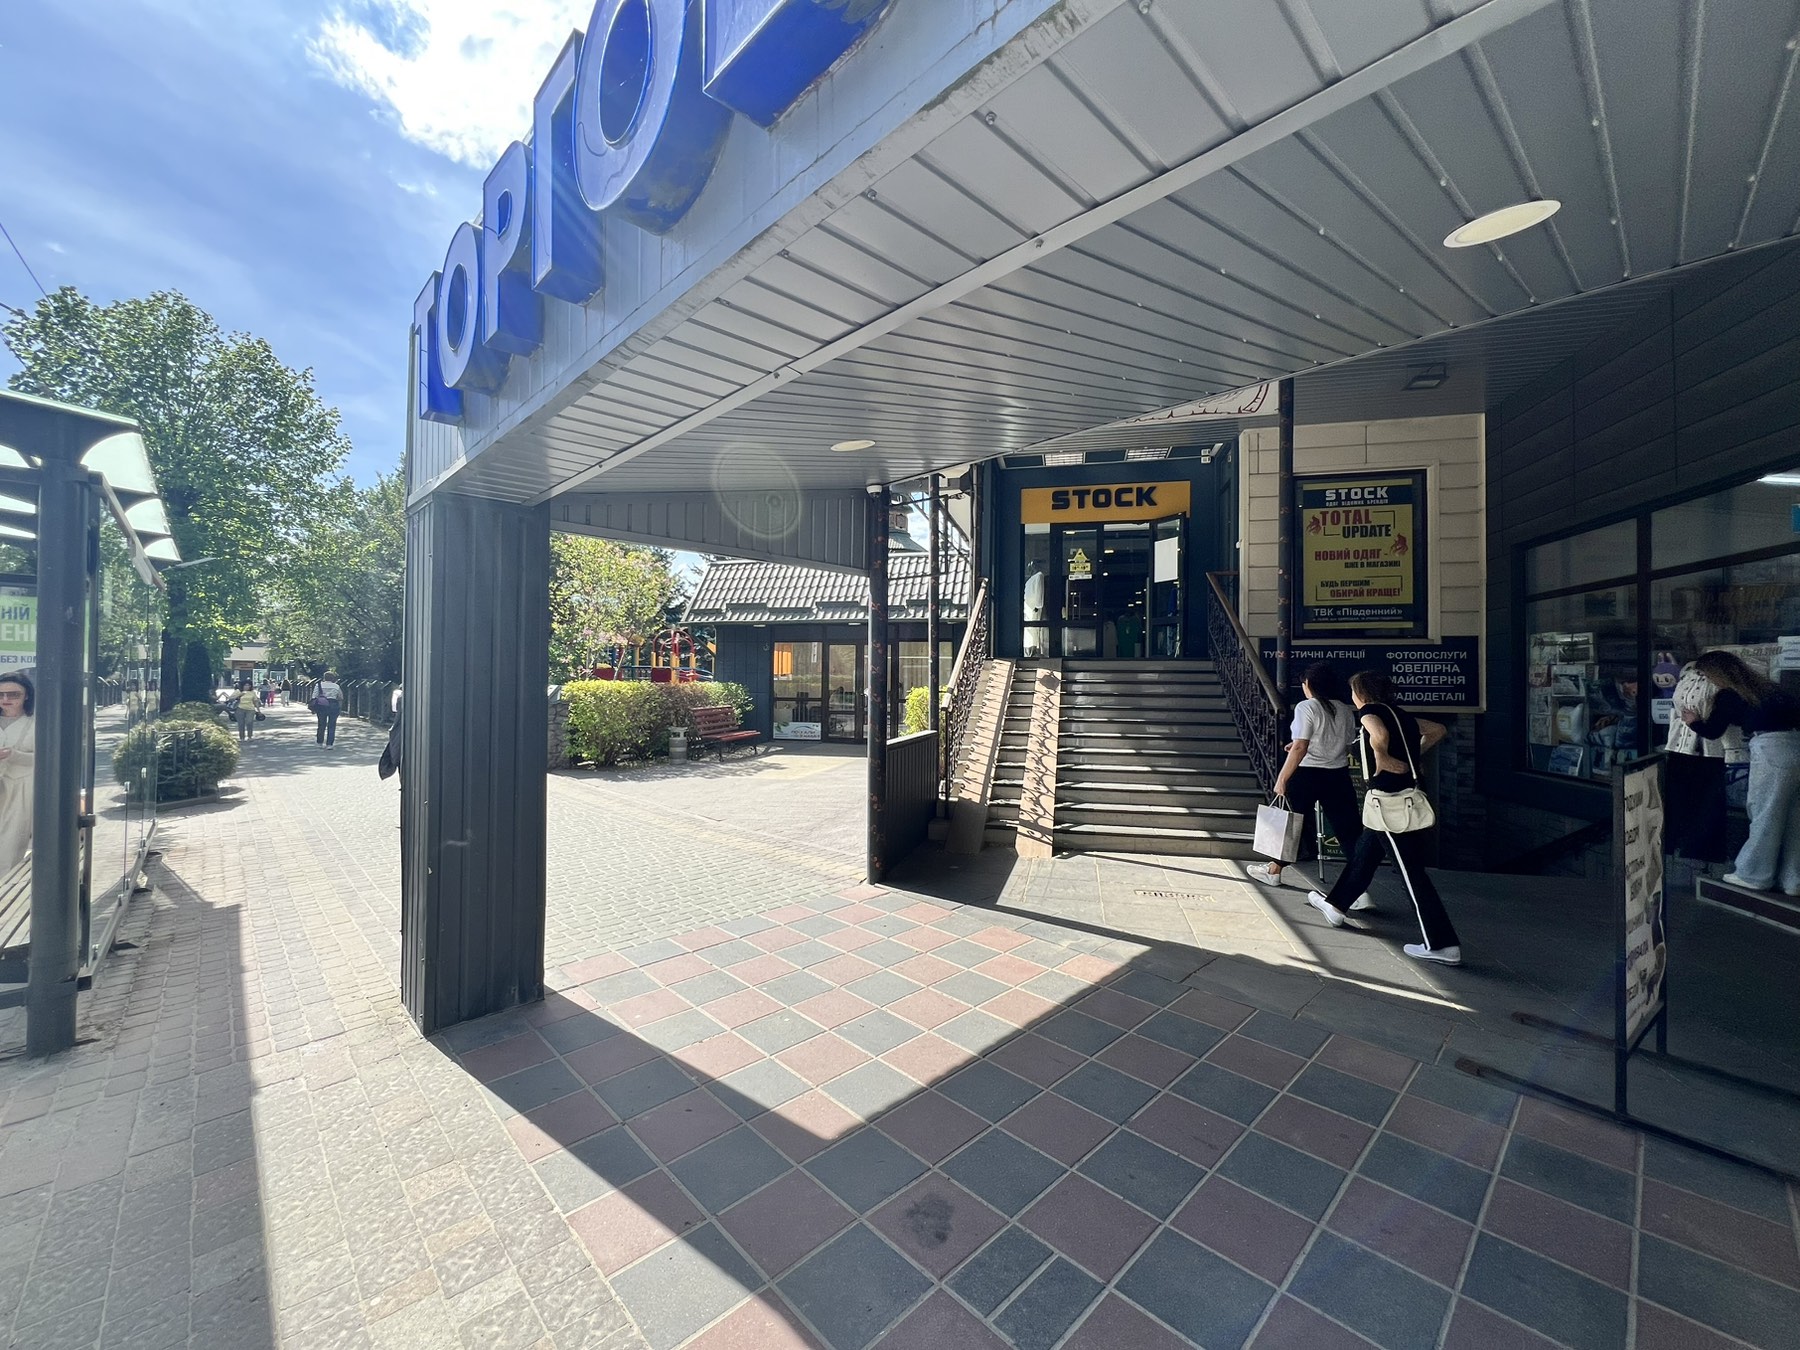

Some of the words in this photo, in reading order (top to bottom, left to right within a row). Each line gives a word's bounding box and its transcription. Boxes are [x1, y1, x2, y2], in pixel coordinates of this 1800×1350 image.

[1051, 486, 1158, 510] STOCK
[1325, 487, 1388, 501] STOCK
[1320, 509, 1372, 526] TOTAL
[1342, 525, 1392, 538] UPDATE
[1314, 548, 1350, 561] НОВИЙ
[1353, 549, 1382, 561] ОДЯГ
[1366, 560, 1401, 568] МАГАЗИНІ
[1320, 580, 1339, 588] БУДЬ
[1330, 587, 1364, 598] ОБИРАЙ
[1366, 587, 1401, 598] КРАЩЕ!
[1313, 608, 1334, 616] ТВК
[1336, 606, 1403, 617] «Південний»
[0, 655, 18, 663] БЕЗ
[1327, 650, 1366, 660] АГЕНЦІЇ
[1386, 651, 1467, 660] ФОТОПОСЛУГИ
[1392, 664, 1461, 673] ЮВЕЛІРНА
[1388, 673, 1466, 684] МАЙСТЕРНЯ
